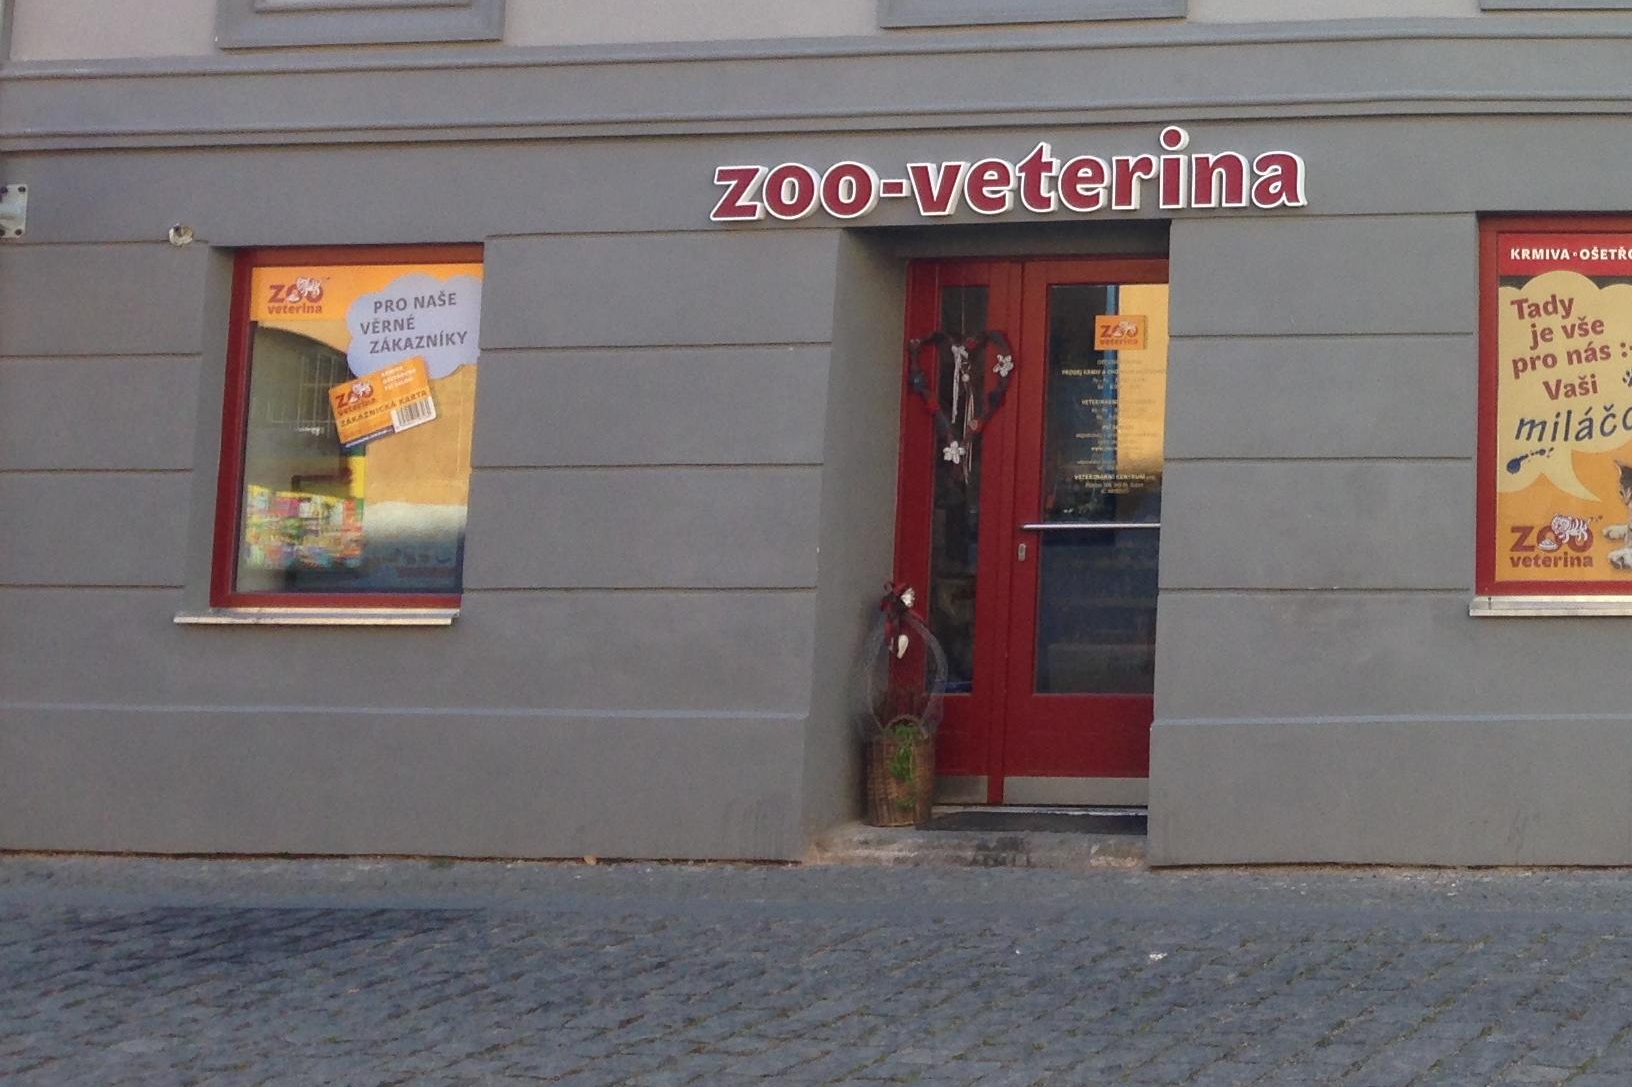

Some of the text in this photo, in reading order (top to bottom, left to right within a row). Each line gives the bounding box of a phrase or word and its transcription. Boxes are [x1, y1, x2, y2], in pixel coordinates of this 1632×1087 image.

[711, 126, 1307, 221] zoo-veterina
[1510, 248, 1570, 261] KRMIVA
[267, 303, 322, 315] veterina
[373, 291, 457, 314] PRO NAŠE
[1510, 293, 1574, 320] Tady
[360, 314, 416, 335] VĚRNÉ
[1529, 315, 1605, 350] je vše
[369, 330, 468, 354] ZÁKAZNÍKY
[1511, 352, 1558, 380] pro
[1566, 341, 1612, 366] nás
[1542, 373, 1598, 401] Vaši
[1509, 552, 1594, 568] veterina
